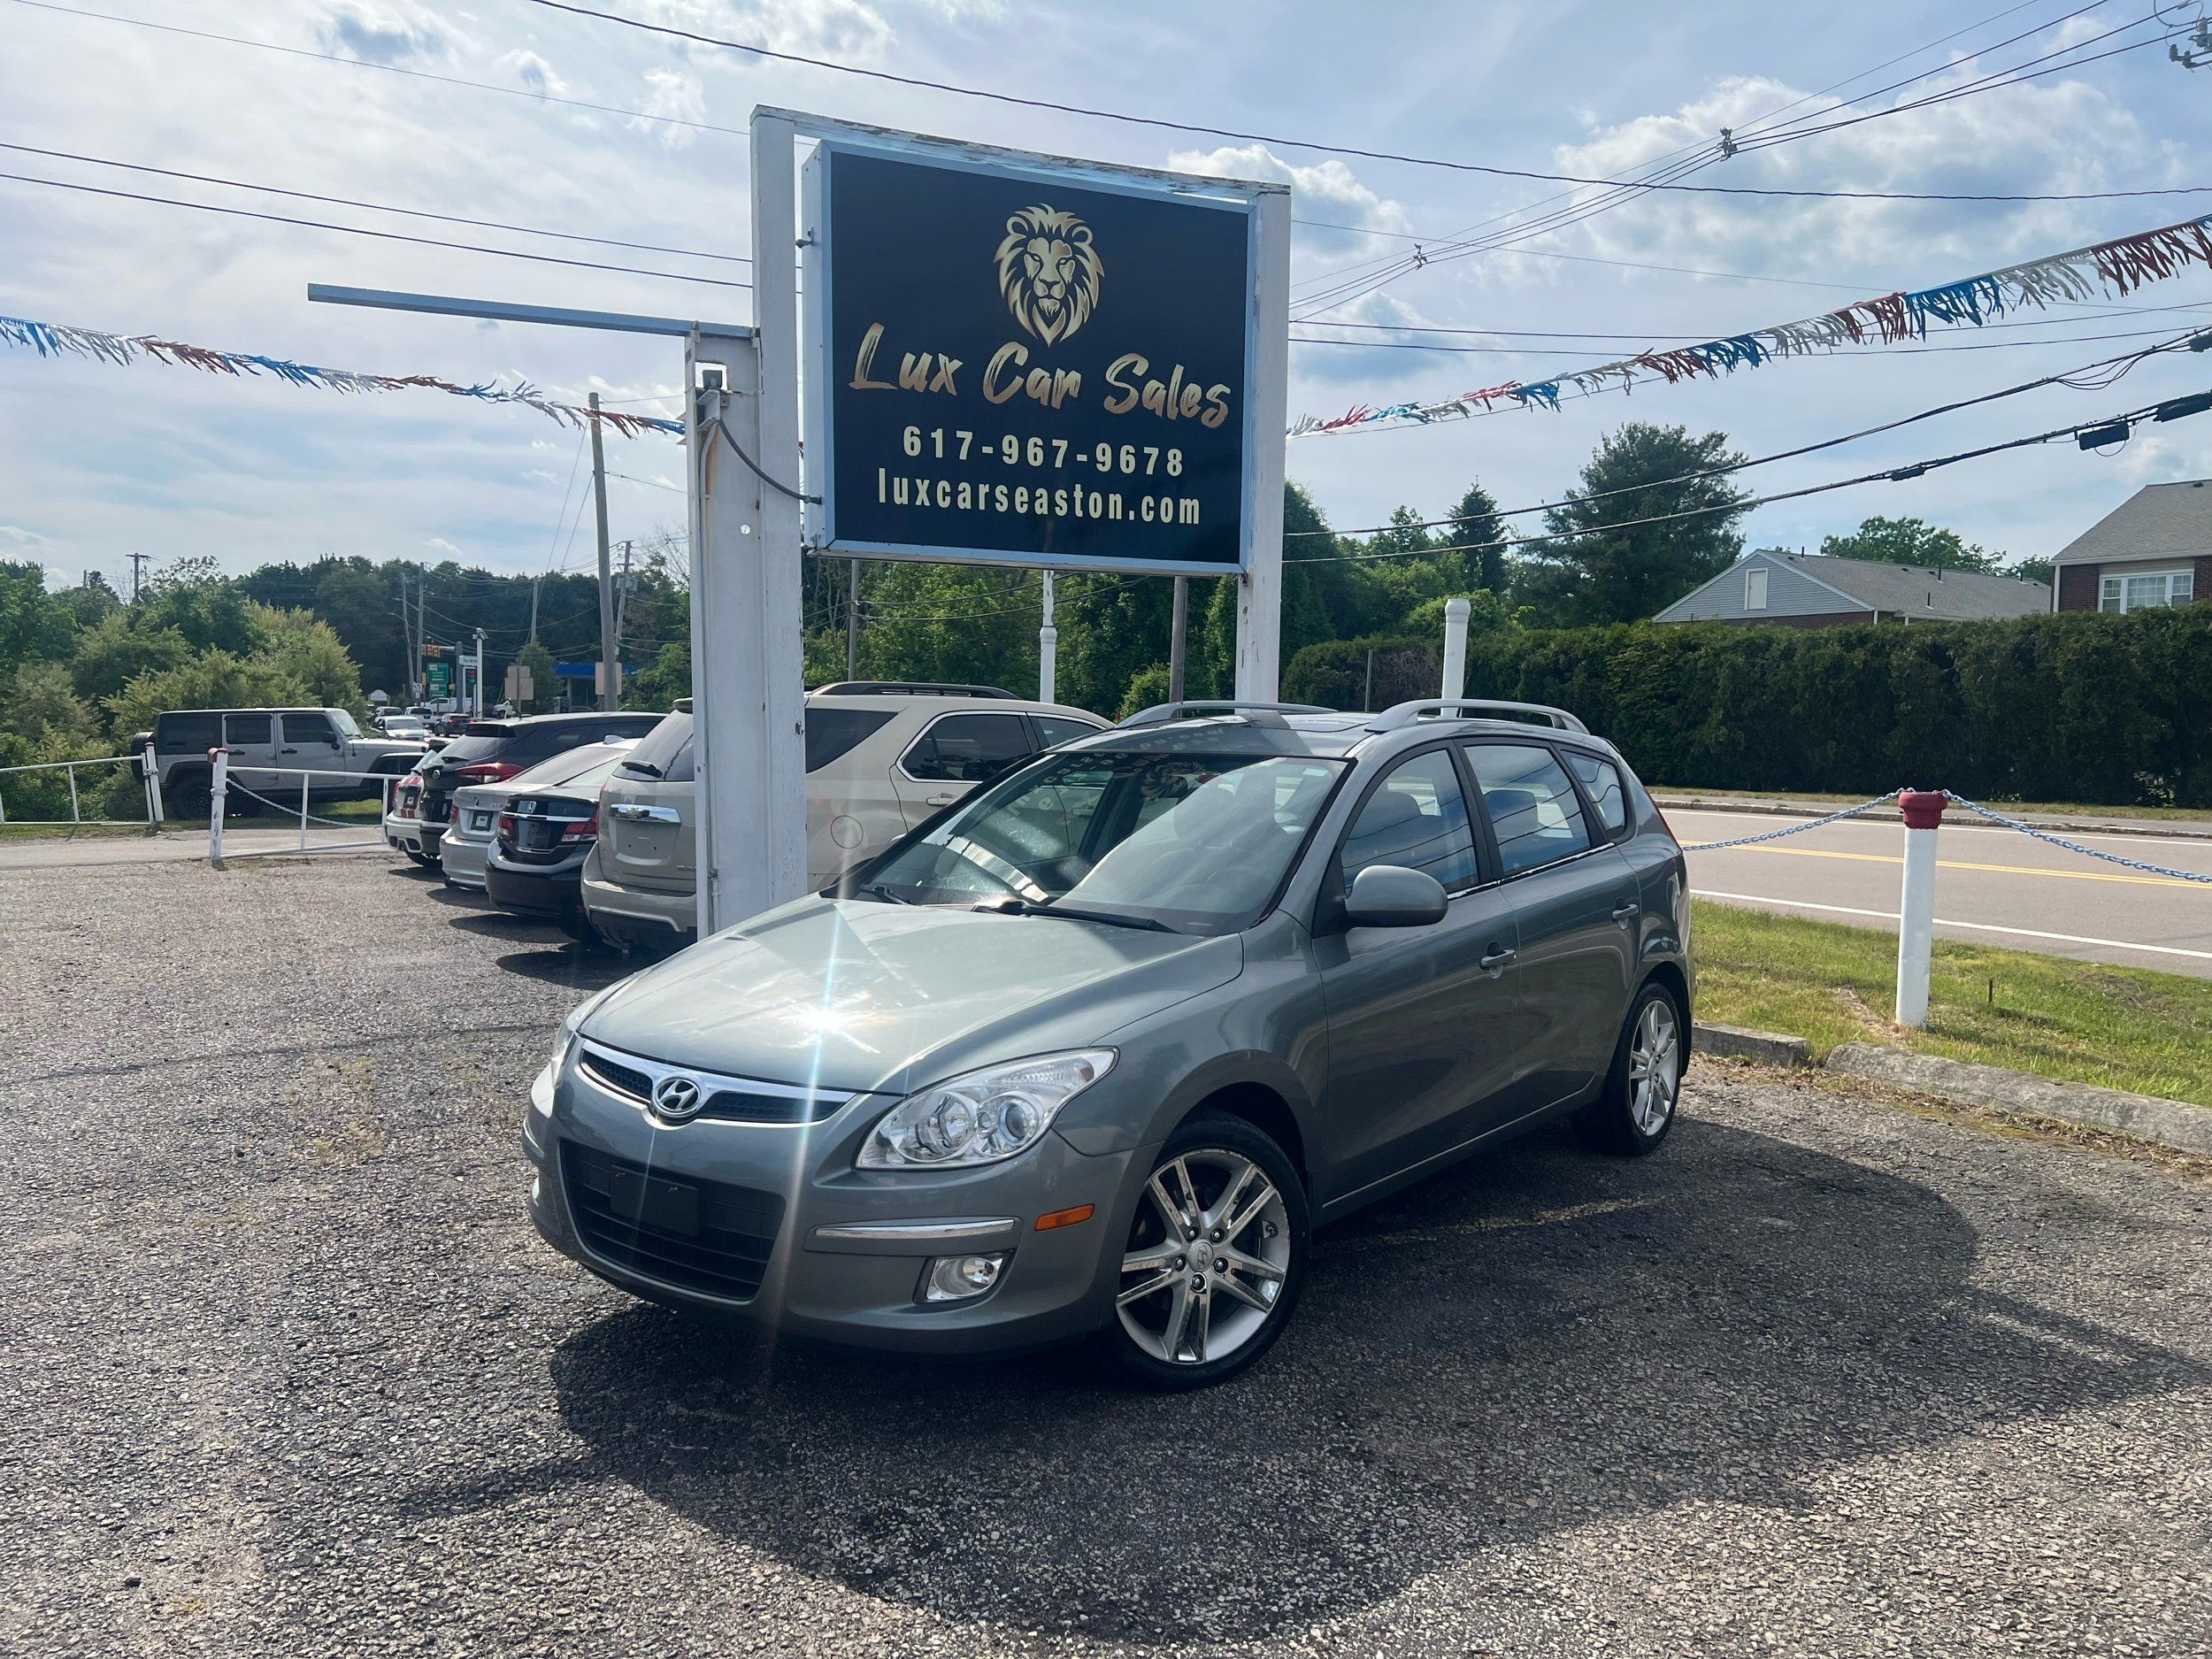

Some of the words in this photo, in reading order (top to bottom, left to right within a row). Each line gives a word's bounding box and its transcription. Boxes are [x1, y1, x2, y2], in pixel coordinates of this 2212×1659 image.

[848, 322, 964, 396] Lux
[982, 341, 1082, 410] Car
[1103, 352, 1232, 429] Sales
[902, 425, 1184, 478] 617-967-9678
[878, 467, 1201, 526] luxcarseaston.com
